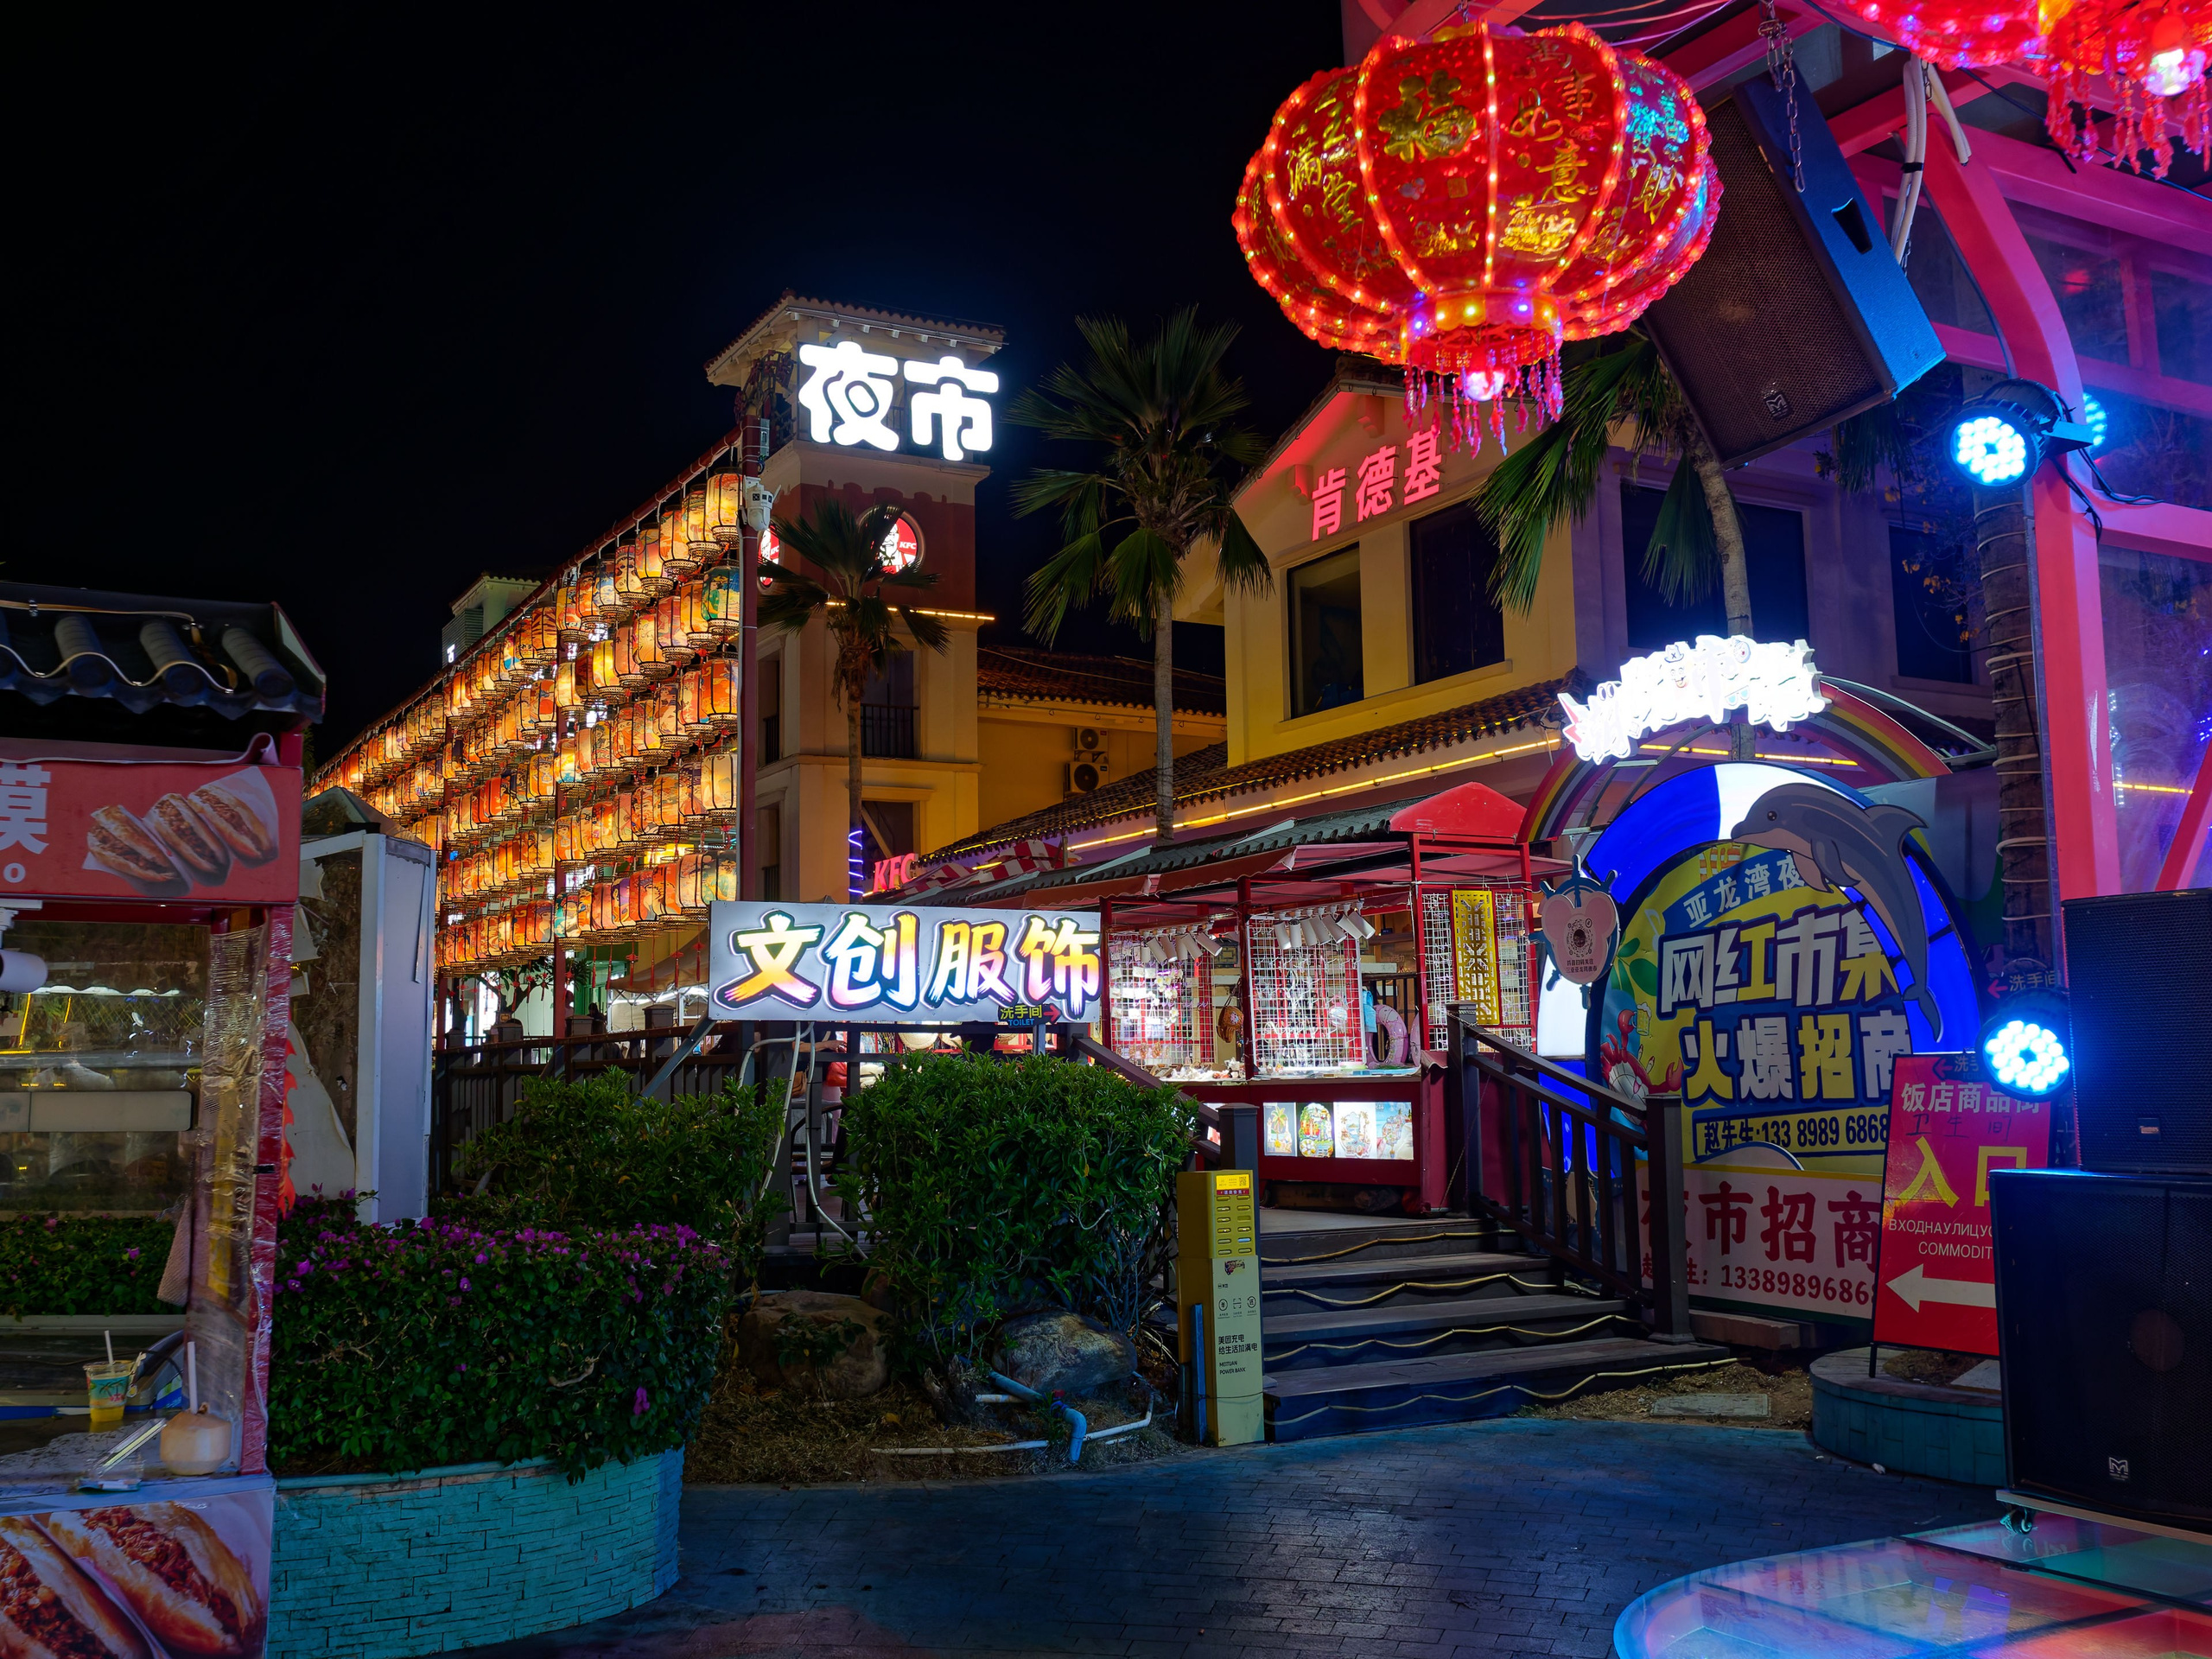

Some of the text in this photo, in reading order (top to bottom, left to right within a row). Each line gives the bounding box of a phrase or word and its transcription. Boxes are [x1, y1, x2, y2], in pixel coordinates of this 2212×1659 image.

[798, 340, 1000, 461] 夜市
[1312, 428, 1442, 542] 肯德基
[899, 541, 917, 550] KFC
[873, 853, 916, 893] KFC
[719, 912, 1100, 1018] 文创服饰
[1660, 907, 1899, 1014] 网红市集
[1000, 1004, 1042, 1020] 洗手间
[1684, 1009, 1912, 1099] 火爆招商
[1798, 1117, 1840, 1146] 8989
[1847, 1114, 1889, 1145] 6868
[1906, 1114, 2012, 1141] 卫生间
[1721, 1264, 1878, 1305] 1338989686
[1218, 1334, 1244, 1344] 美团充电
[1218, 1343, 1258, 1355] 给生活加满电
